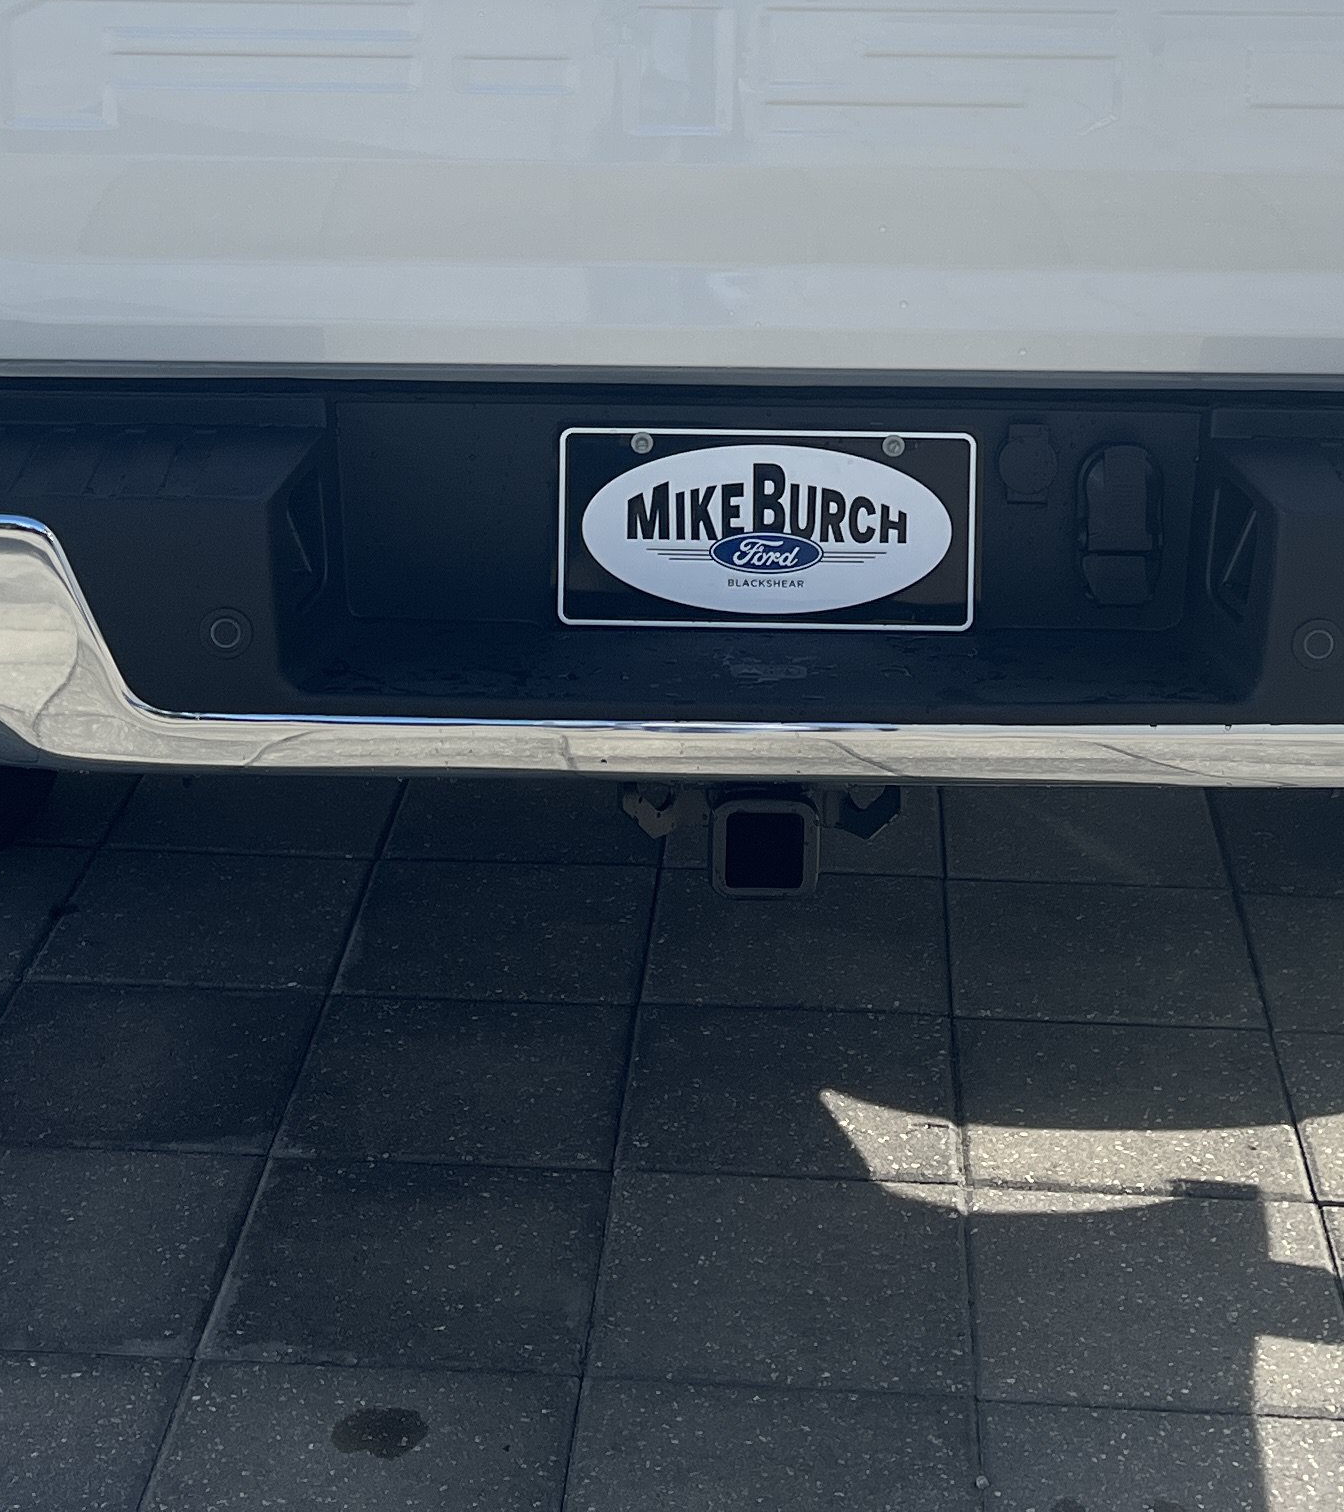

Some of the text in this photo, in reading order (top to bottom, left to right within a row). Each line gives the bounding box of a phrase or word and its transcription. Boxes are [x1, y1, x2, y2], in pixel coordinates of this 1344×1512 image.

[626, 462, 908, 545] MIKE BURCH
[732, 537, 799, 568] Ford
[727, 578, 805, 589] BLACKSHEAR
